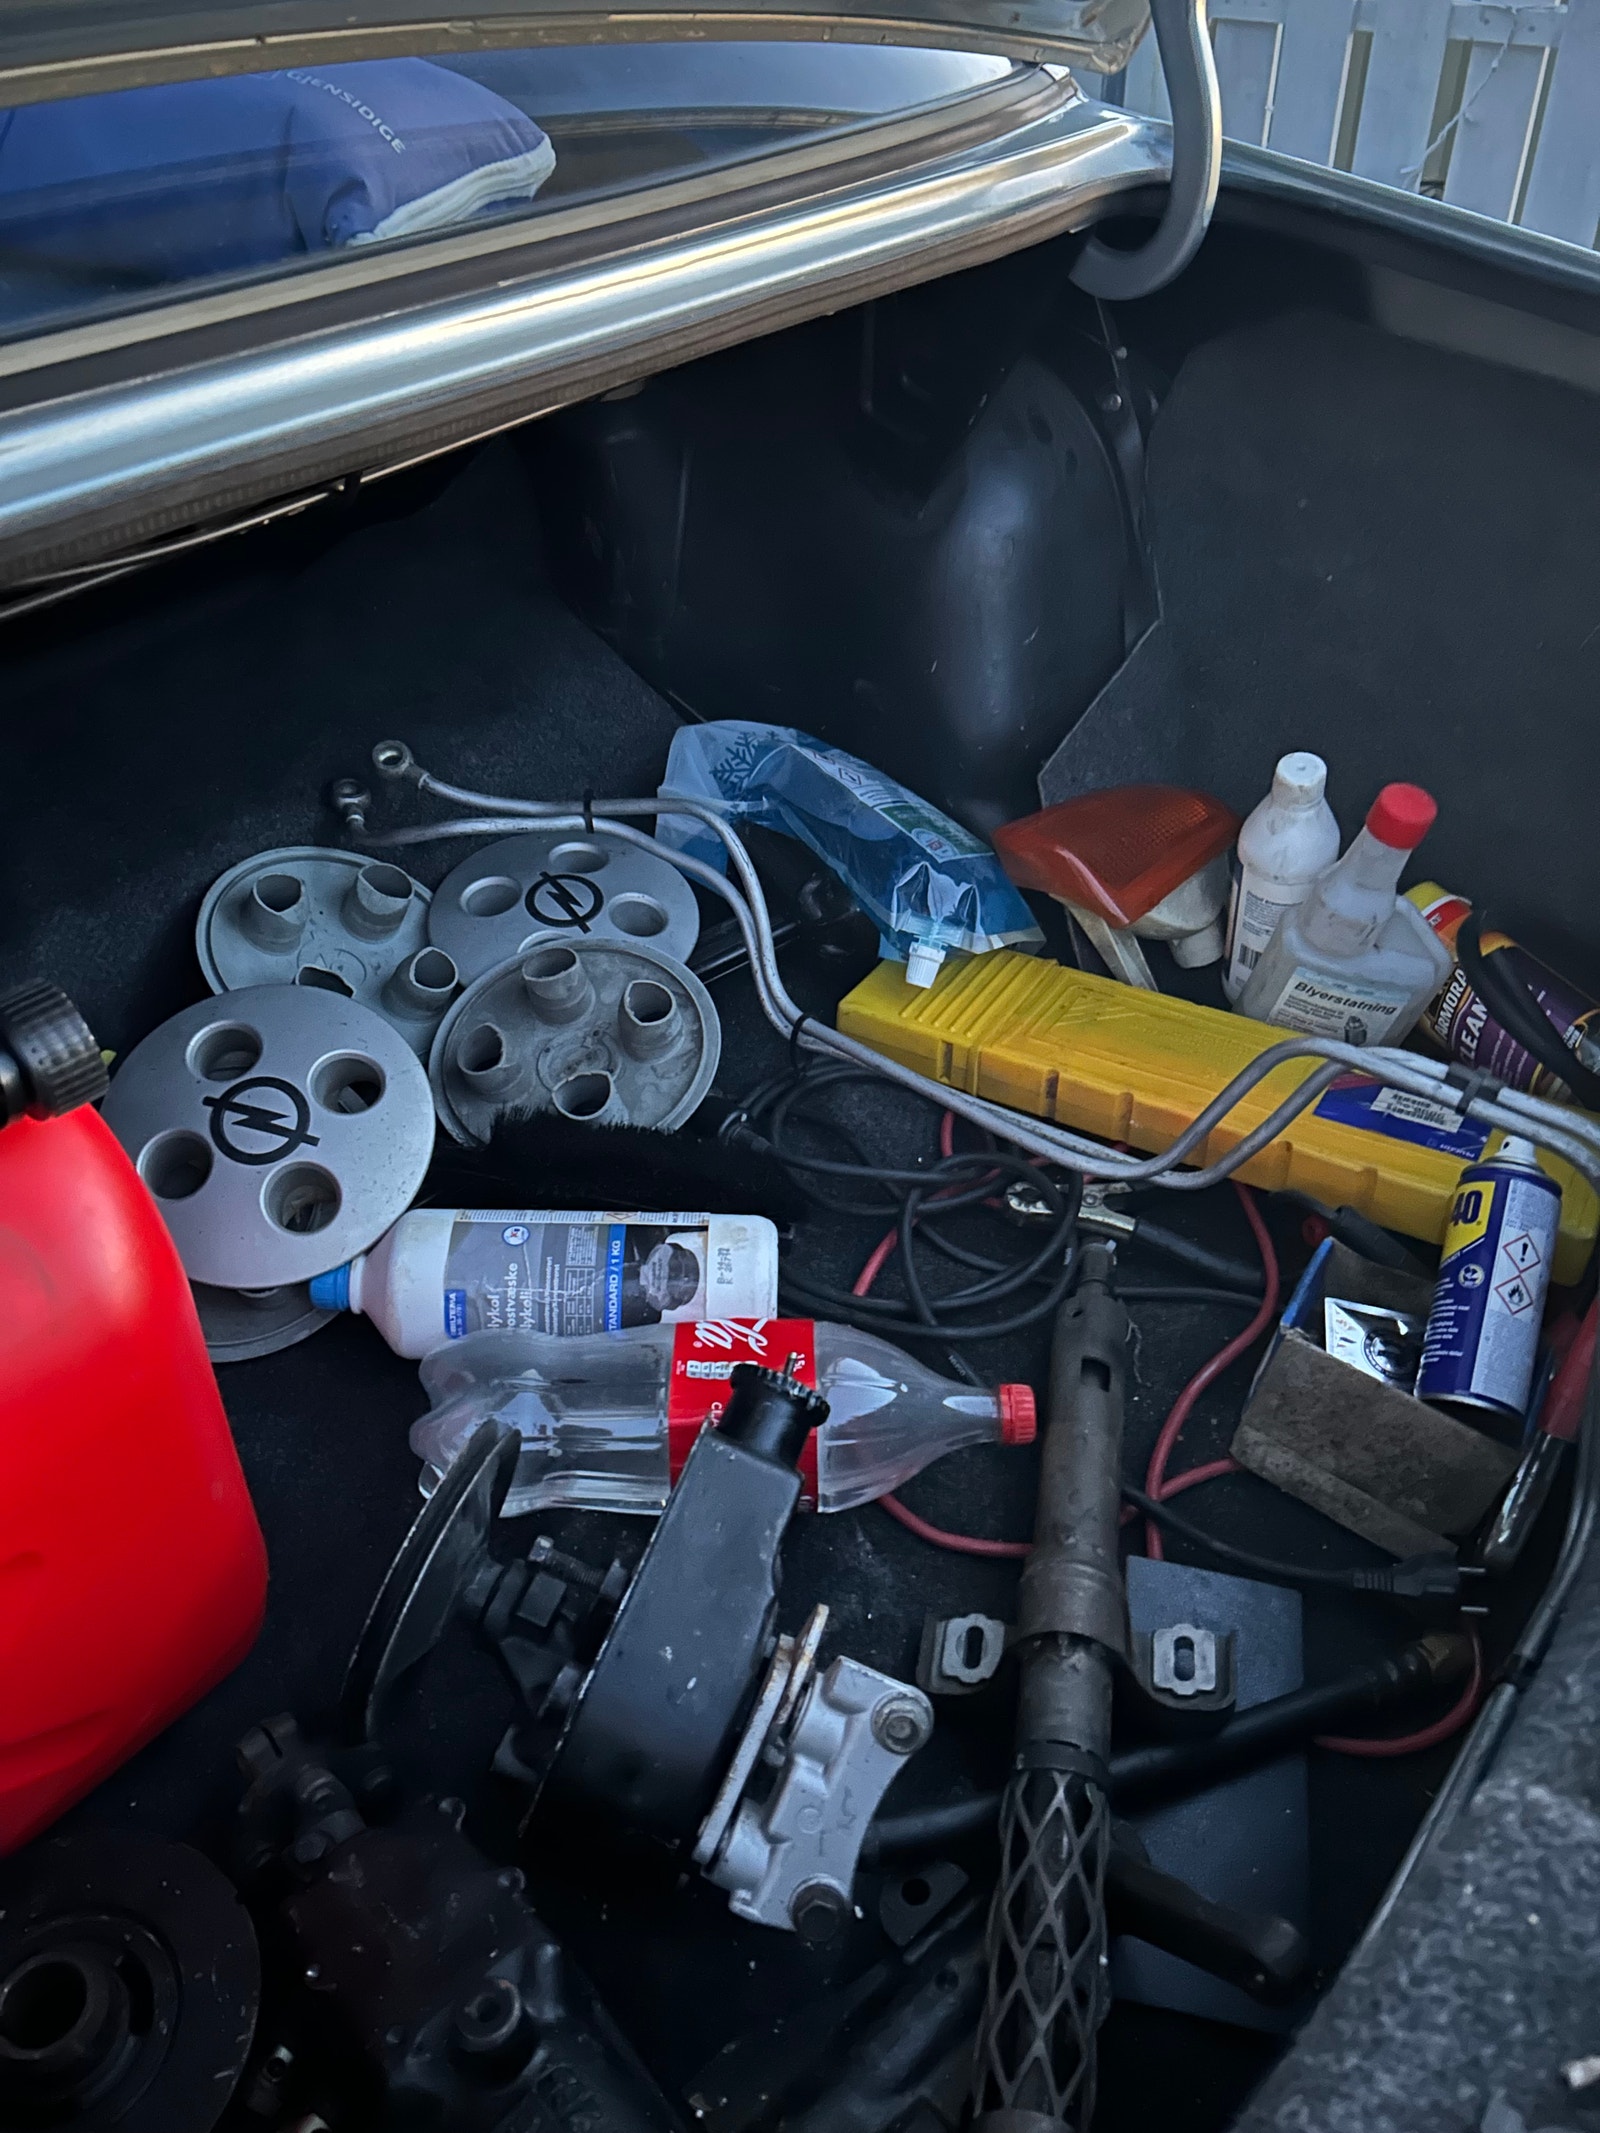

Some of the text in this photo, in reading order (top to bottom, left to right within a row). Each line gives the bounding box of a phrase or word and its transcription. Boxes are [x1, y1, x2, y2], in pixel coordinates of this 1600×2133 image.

[286, 70, 406, 154] GJENSIDIGE
[1293, 981, 1399, 1016] Blyerstatning
[611, 1239, 622, 1256] KG
[486, 1294, 503, 1328] lykol
[519, 1290, 536, 1328] lykoli
[608, 1274, 621, 1331] TANDARD
